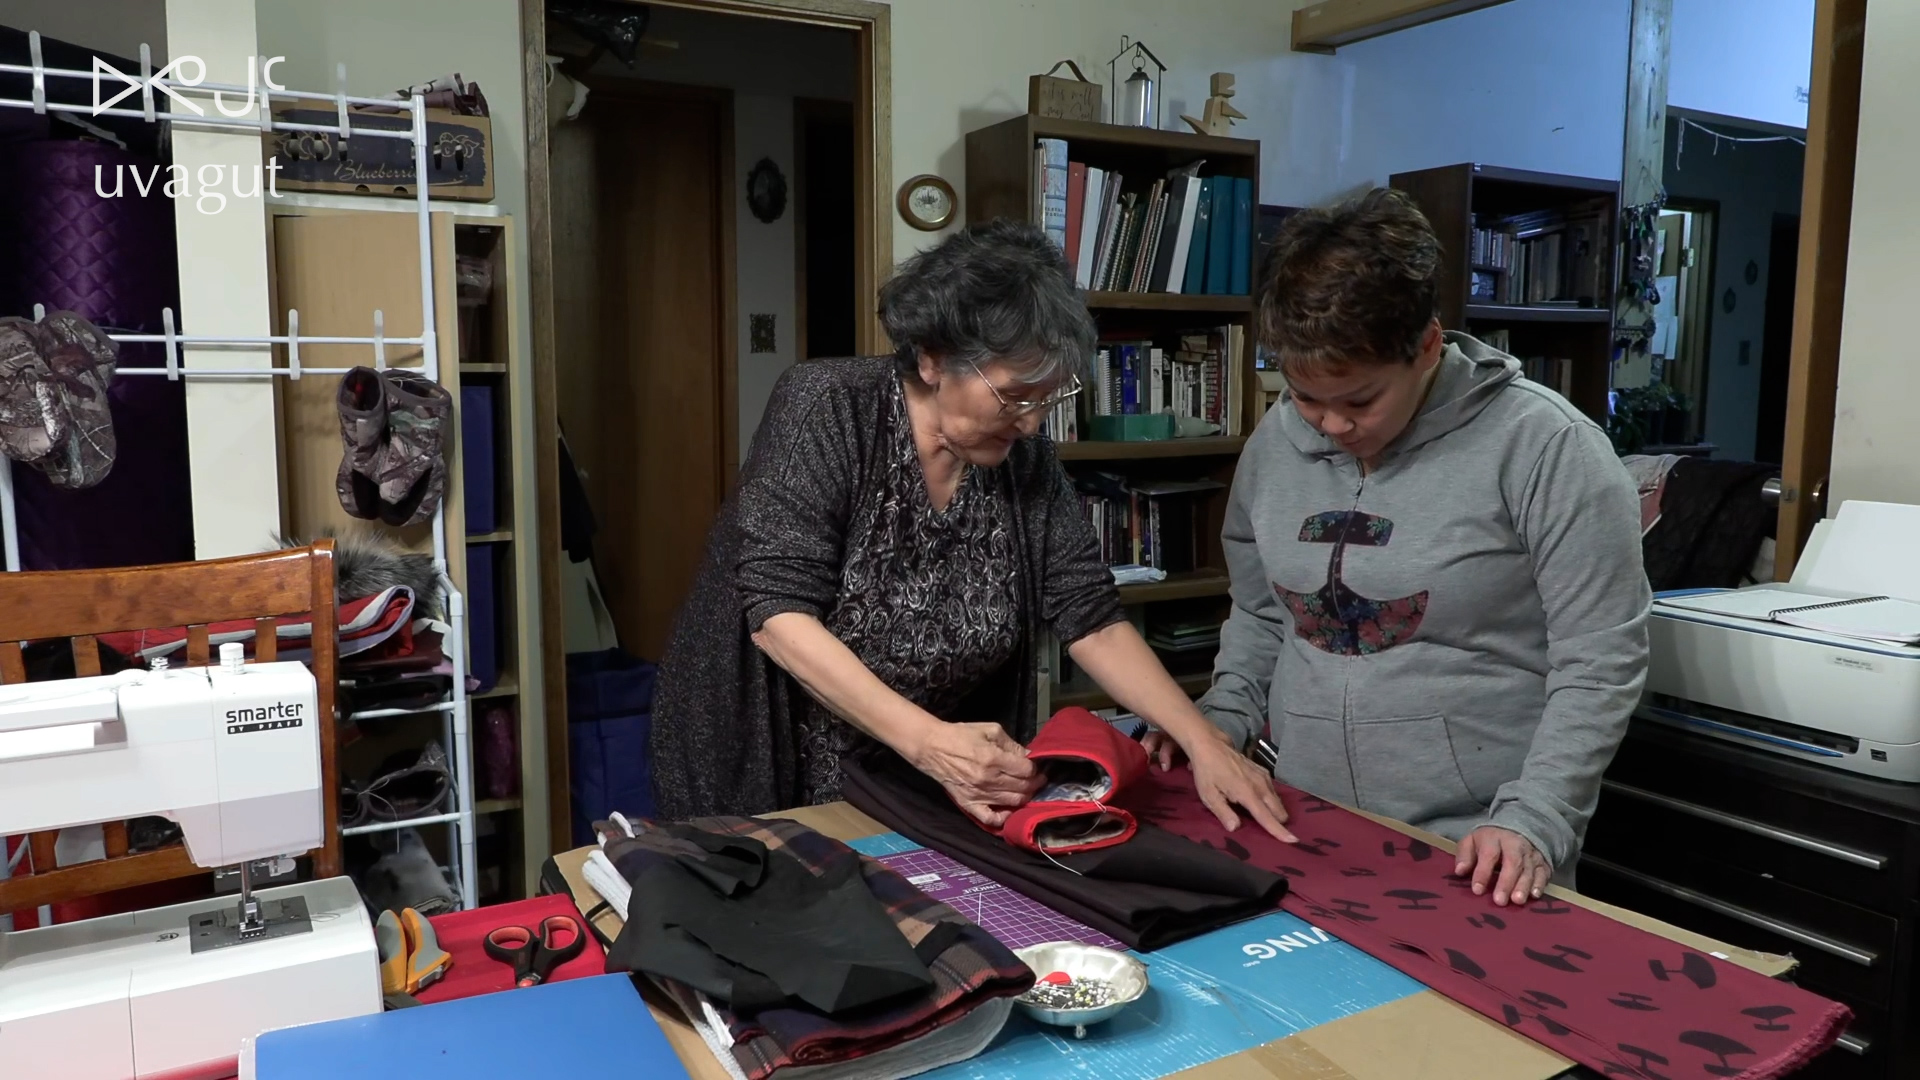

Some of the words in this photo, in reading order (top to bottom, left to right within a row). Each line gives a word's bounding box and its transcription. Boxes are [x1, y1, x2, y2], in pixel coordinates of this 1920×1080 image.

[226, 702, 303, 723] smarter
[259, 720, 300, 730] PFAFF
[962, 883, 1002, 895] UNIQUE
